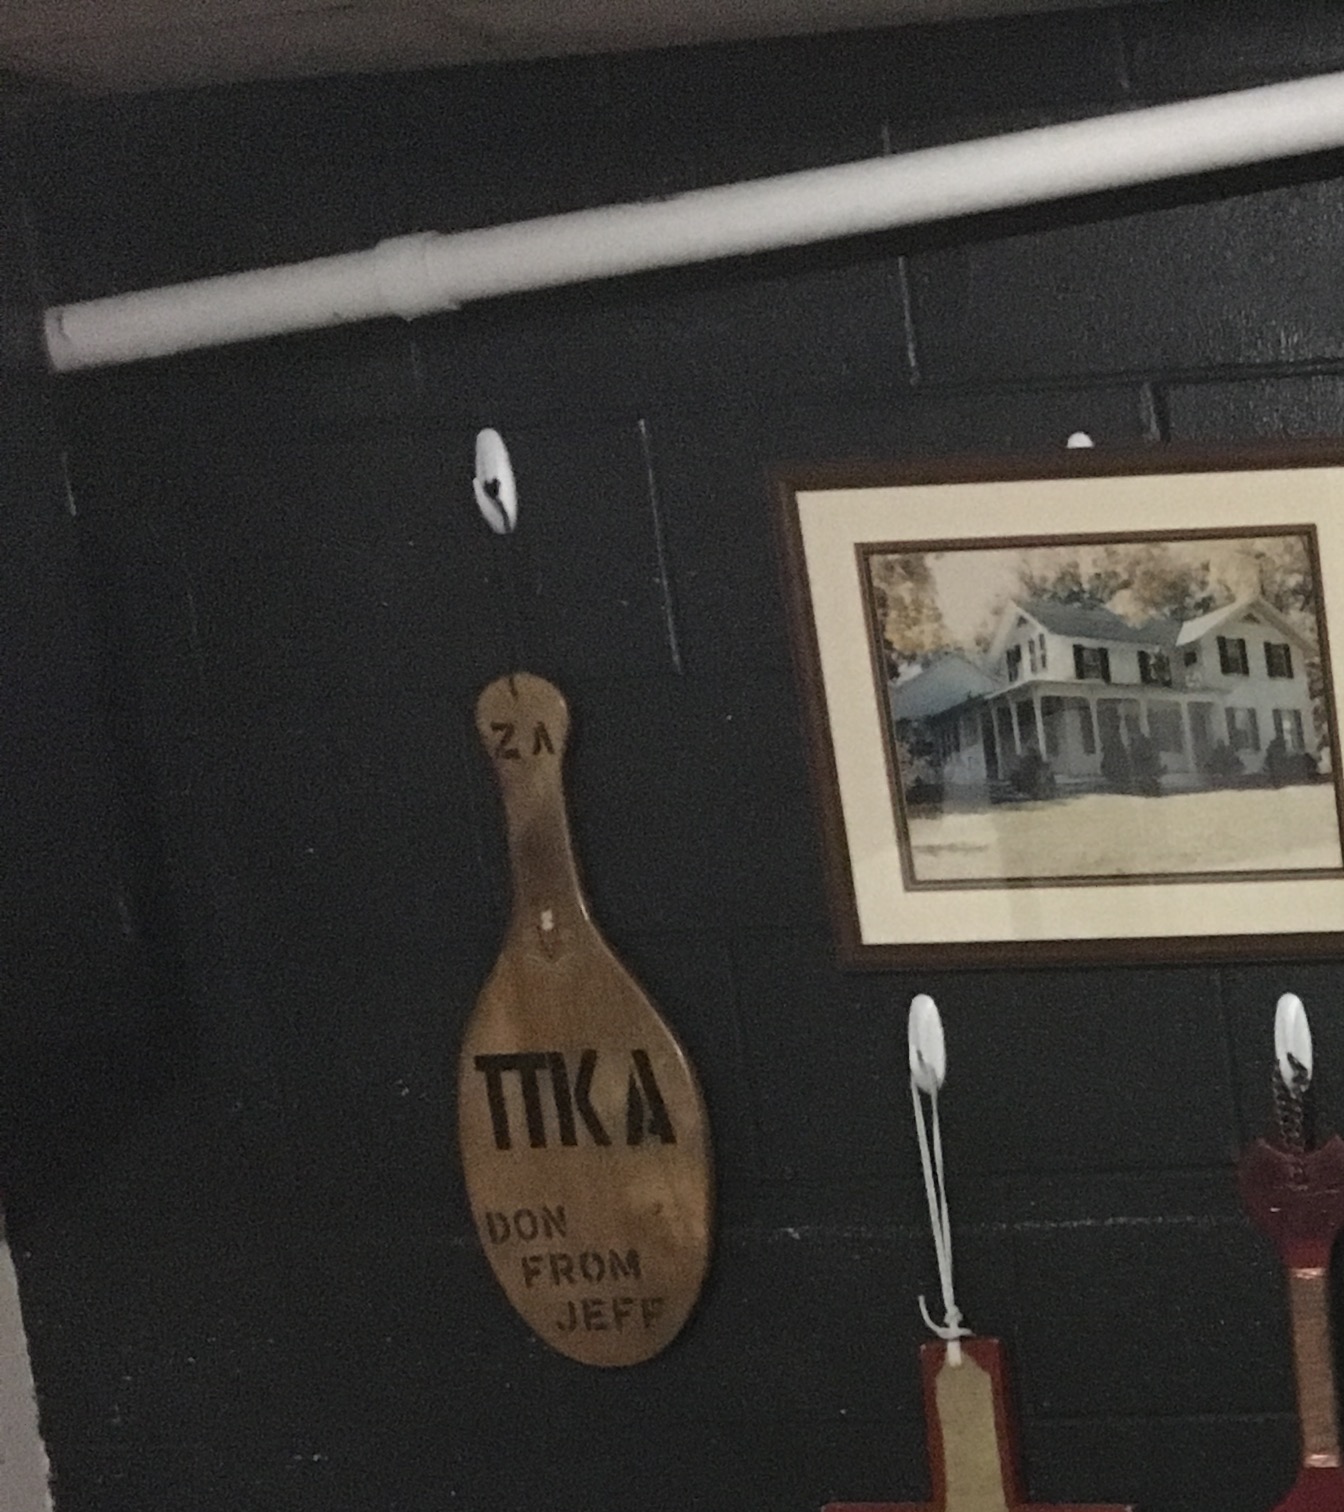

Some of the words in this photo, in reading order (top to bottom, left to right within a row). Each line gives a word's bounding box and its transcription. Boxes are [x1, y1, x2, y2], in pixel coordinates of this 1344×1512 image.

[484, 1205, 569, 1246] DON
[520, 1247, 643, 1290] FROM
[556, 1296, 664, 1333] JEFF
